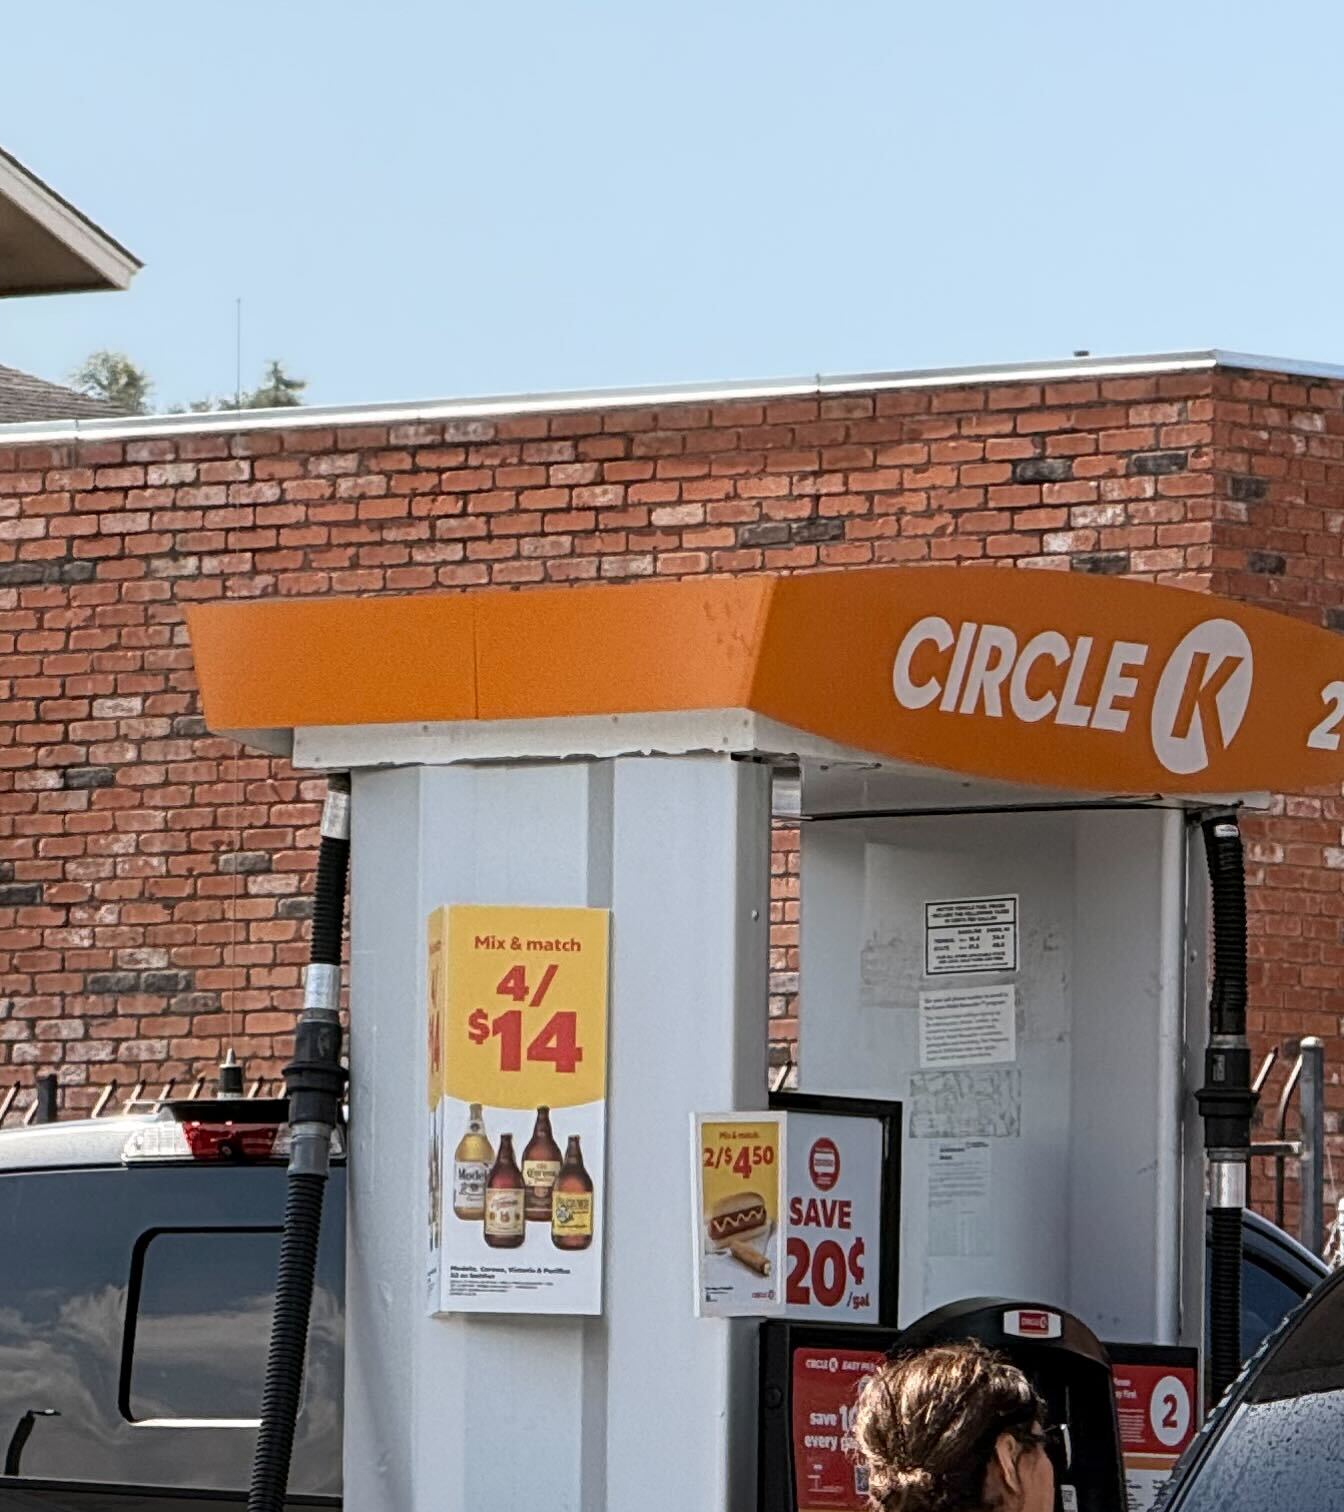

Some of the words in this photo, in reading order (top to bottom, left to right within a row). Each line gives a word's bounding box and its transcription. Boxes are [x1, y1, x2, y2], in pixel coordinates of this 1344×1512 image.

[892, 616, 1149, 733] CIRCLE
[1159, 630, 1251, 774] K
[474, 935, 508, 951] Mix
[512, 937, 523, 951] &
[527, 937, 581, 952] match
[496, 964, 559, 1007] 4/
[468, 1008, 583, 1073] $14
[789, 1196, 852, 1230] SAVE
[787, 1237, 865, 1308] 20¢
[847, 1292, 870, 1310] /gal
[809, 1411, 838, 1427] save
[1162, 1393, 1179, 1429] 2
[804, 1434, 838, 1452] every
